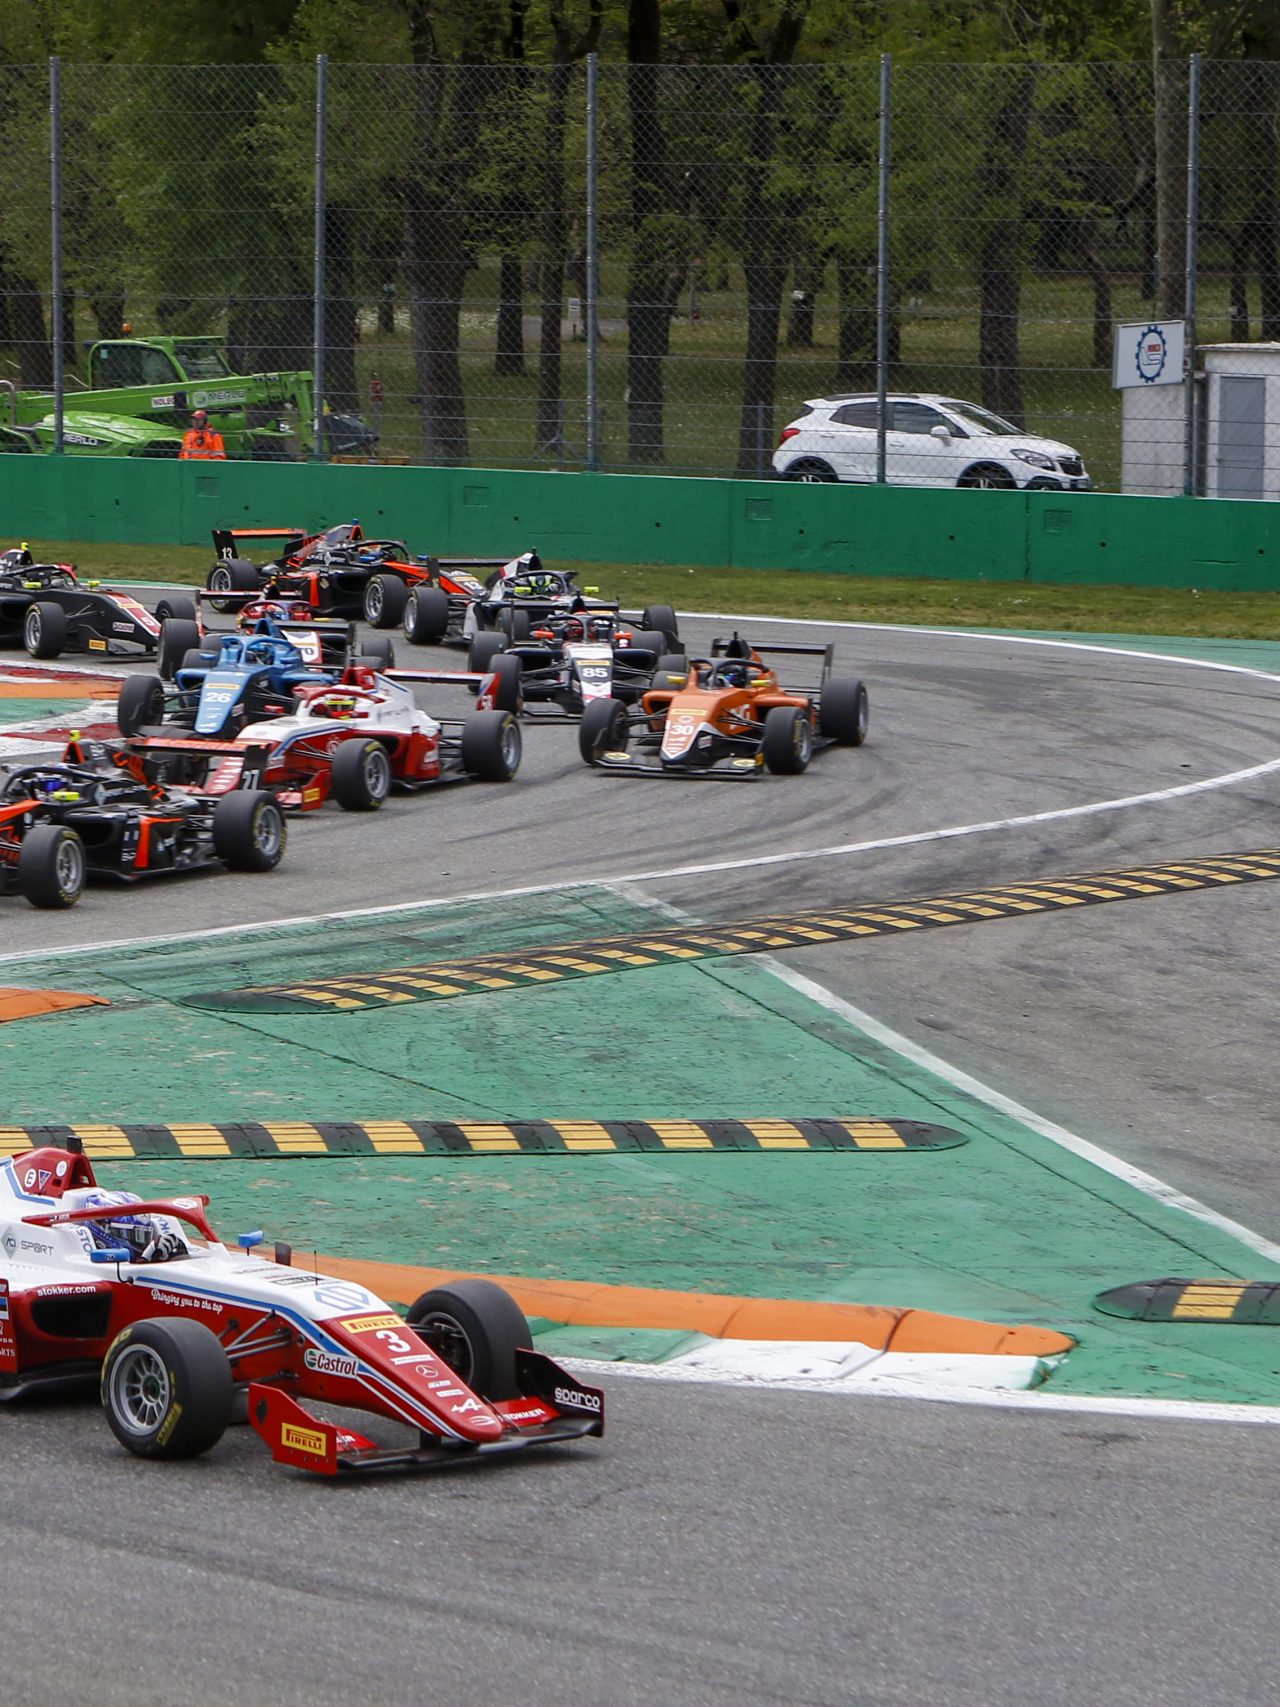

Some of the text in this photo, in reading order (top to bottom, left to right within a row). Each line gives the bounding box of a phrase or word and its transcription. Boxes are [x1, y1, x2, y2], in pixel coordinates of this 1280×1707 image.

[222, 547, 233, 559] 13
[582, 667, 608, 678] 85
[204, 691, 232, 703] 26
[670, 724, 695, 735] 30
[242, 770, 260, 790] 27
[26, 1171, 35, 1185] E
[37, 1284, 96, 1297] stokker.com
[151, 1288, 223, 1315] Bringing you to the top
[351, 1316, 402, 1331] PIRELLI
[375, 1330, 412, 1353] 3
[317, 1353, 357, 1376] Castrol
[554, 1387, 600, 1409] sparco
[286, 1429, 324, 1452] PIRELLI
